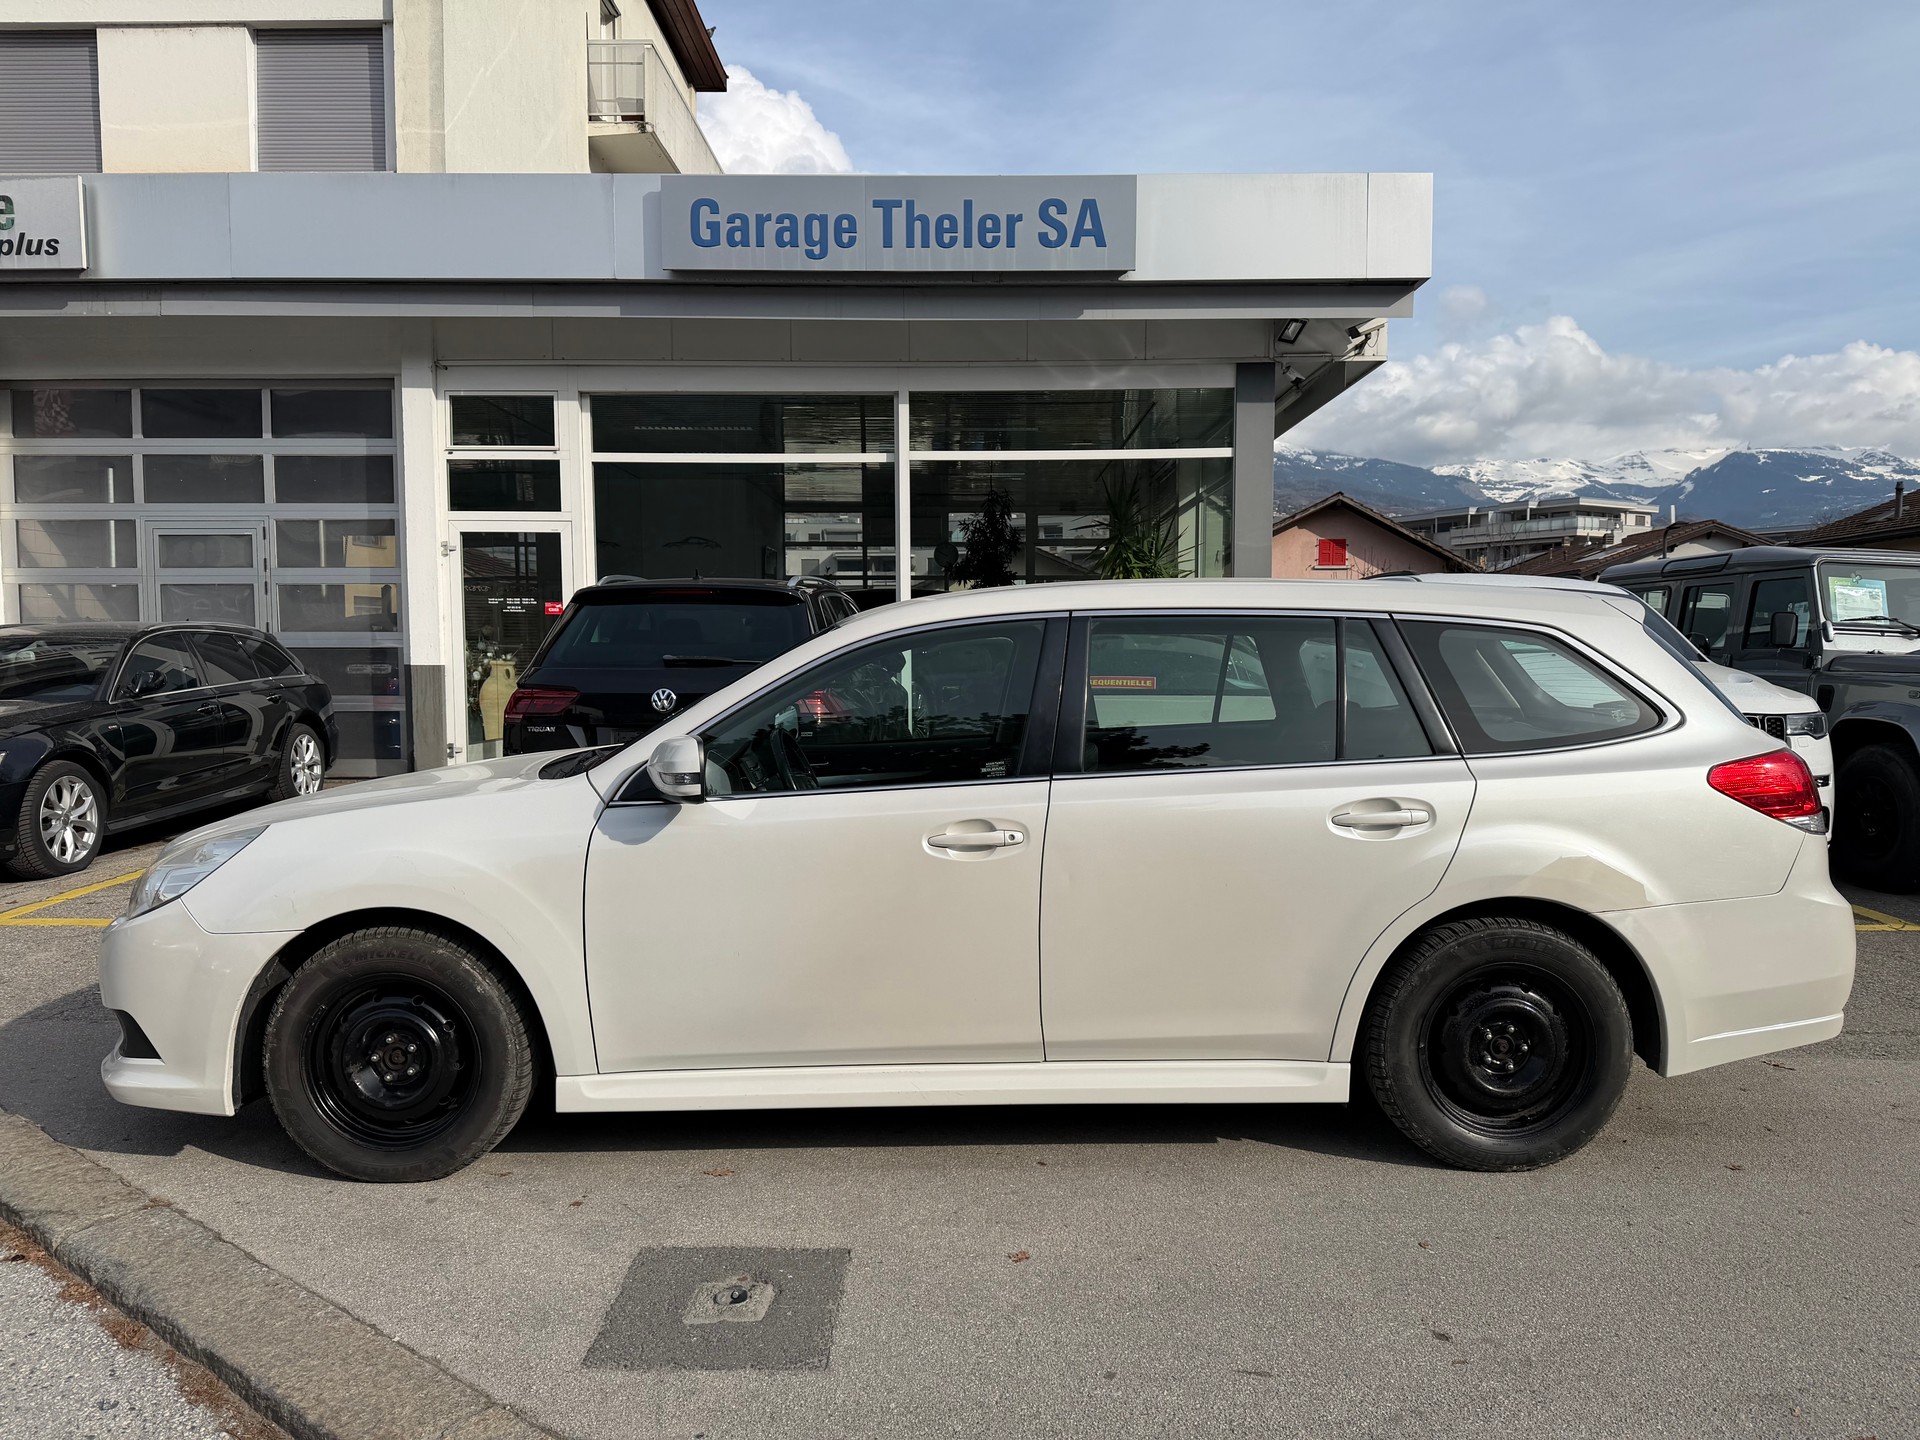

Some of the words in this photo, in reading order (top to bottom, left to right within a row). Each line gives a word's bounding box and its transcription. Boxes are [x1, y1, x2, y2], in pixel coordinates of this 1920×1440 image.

[690, 198, 857, 260] Garage
[872, 199, 1023, 249] Theler
[1037, 198, 1107, 249] SA
